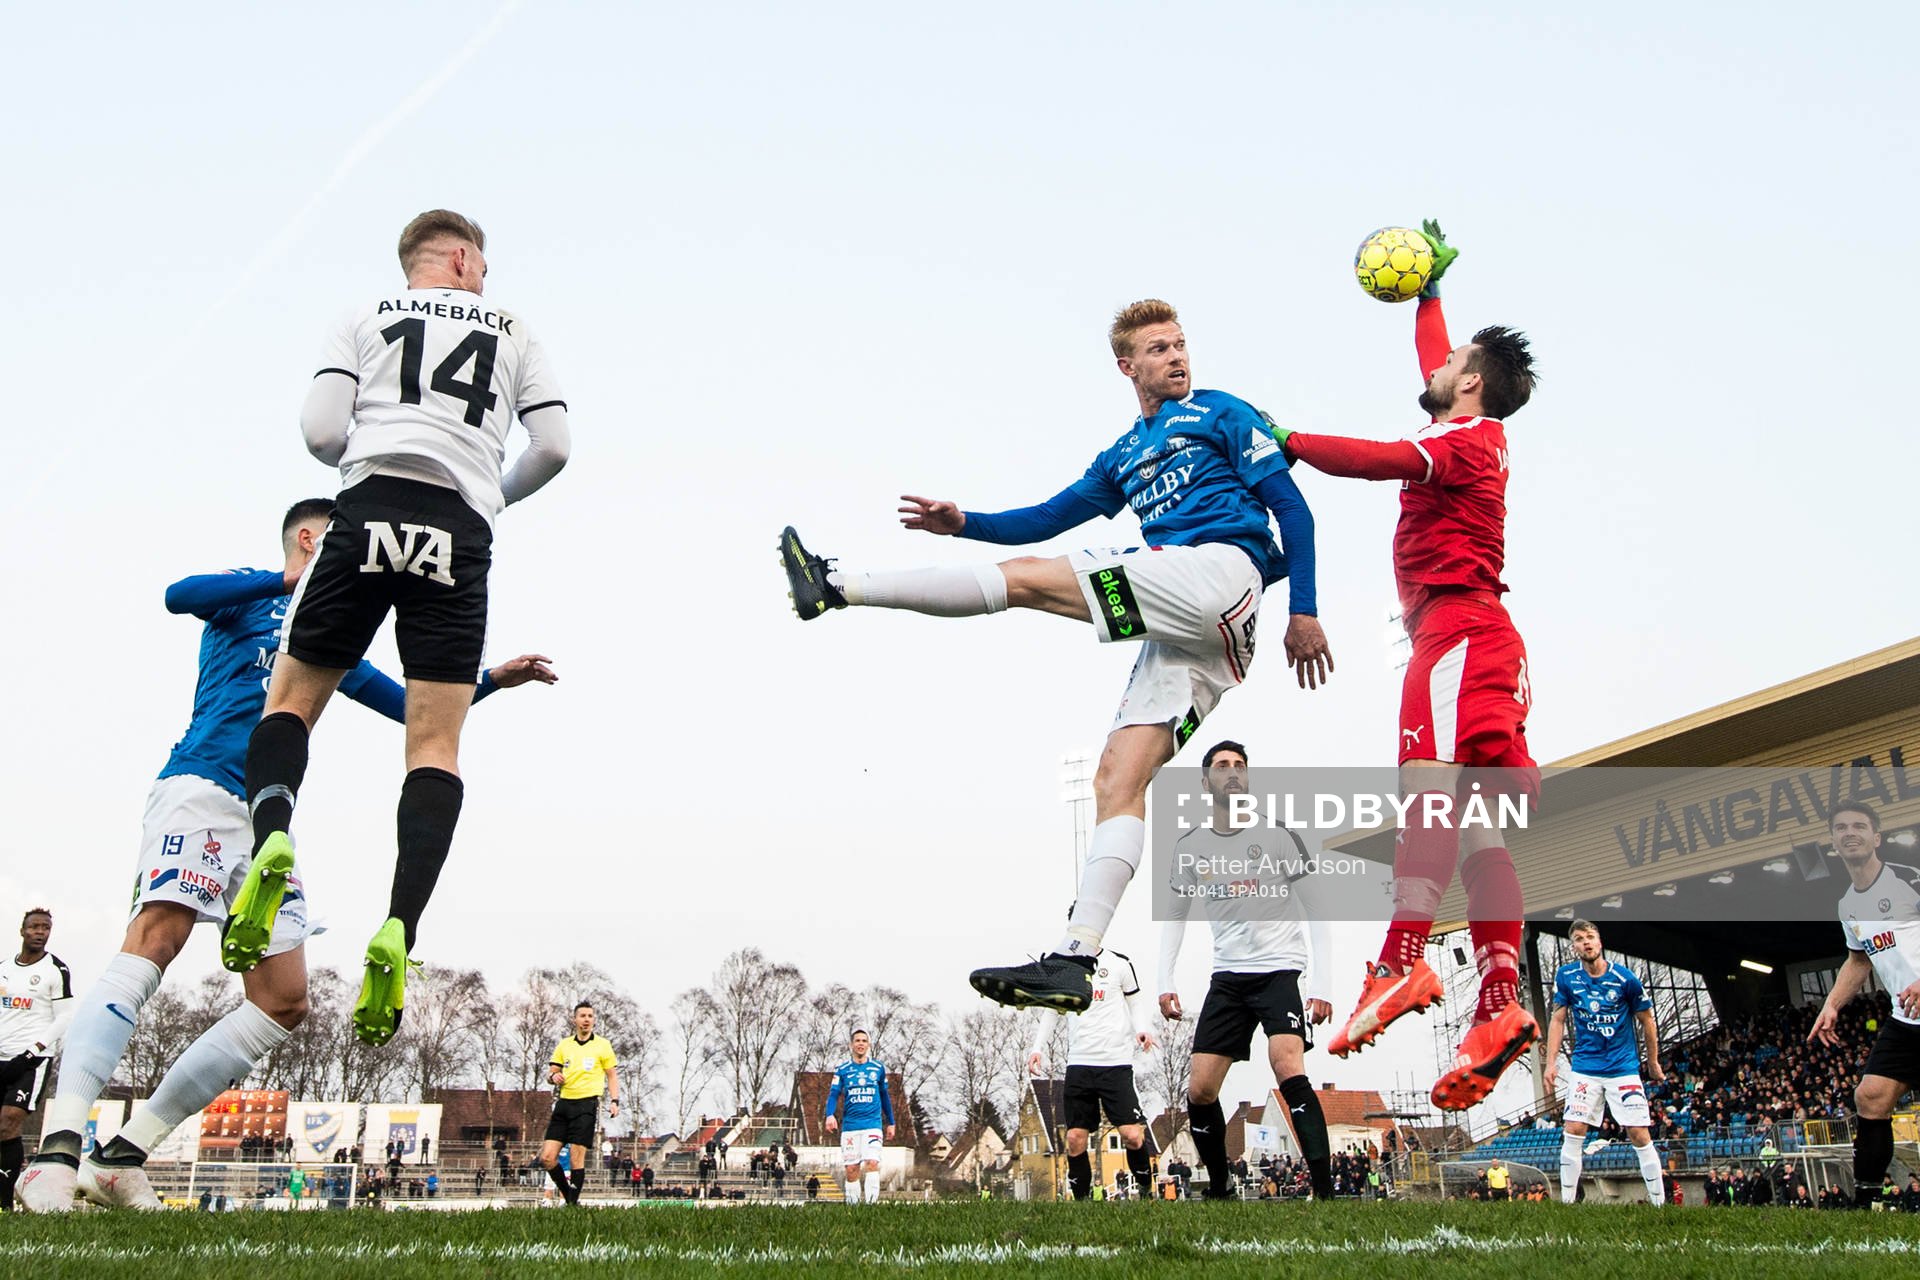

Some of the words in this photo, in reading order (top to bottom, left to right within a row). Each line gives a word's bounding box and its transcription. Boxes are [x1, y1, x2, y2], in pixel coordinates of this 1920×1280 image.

[377, 299, 514, 336] ALMEBÄCK
[380, 317, 498, 429] 14
[359, 521, 456, 587] NA
[1099, 570, 1126, 618] akea
[161, 834, 185, 856] 19
[201, 851, 226, 873] KFX
[179, 882, 215, 909] SPORT
[182, 868, 224, 898] INTER
